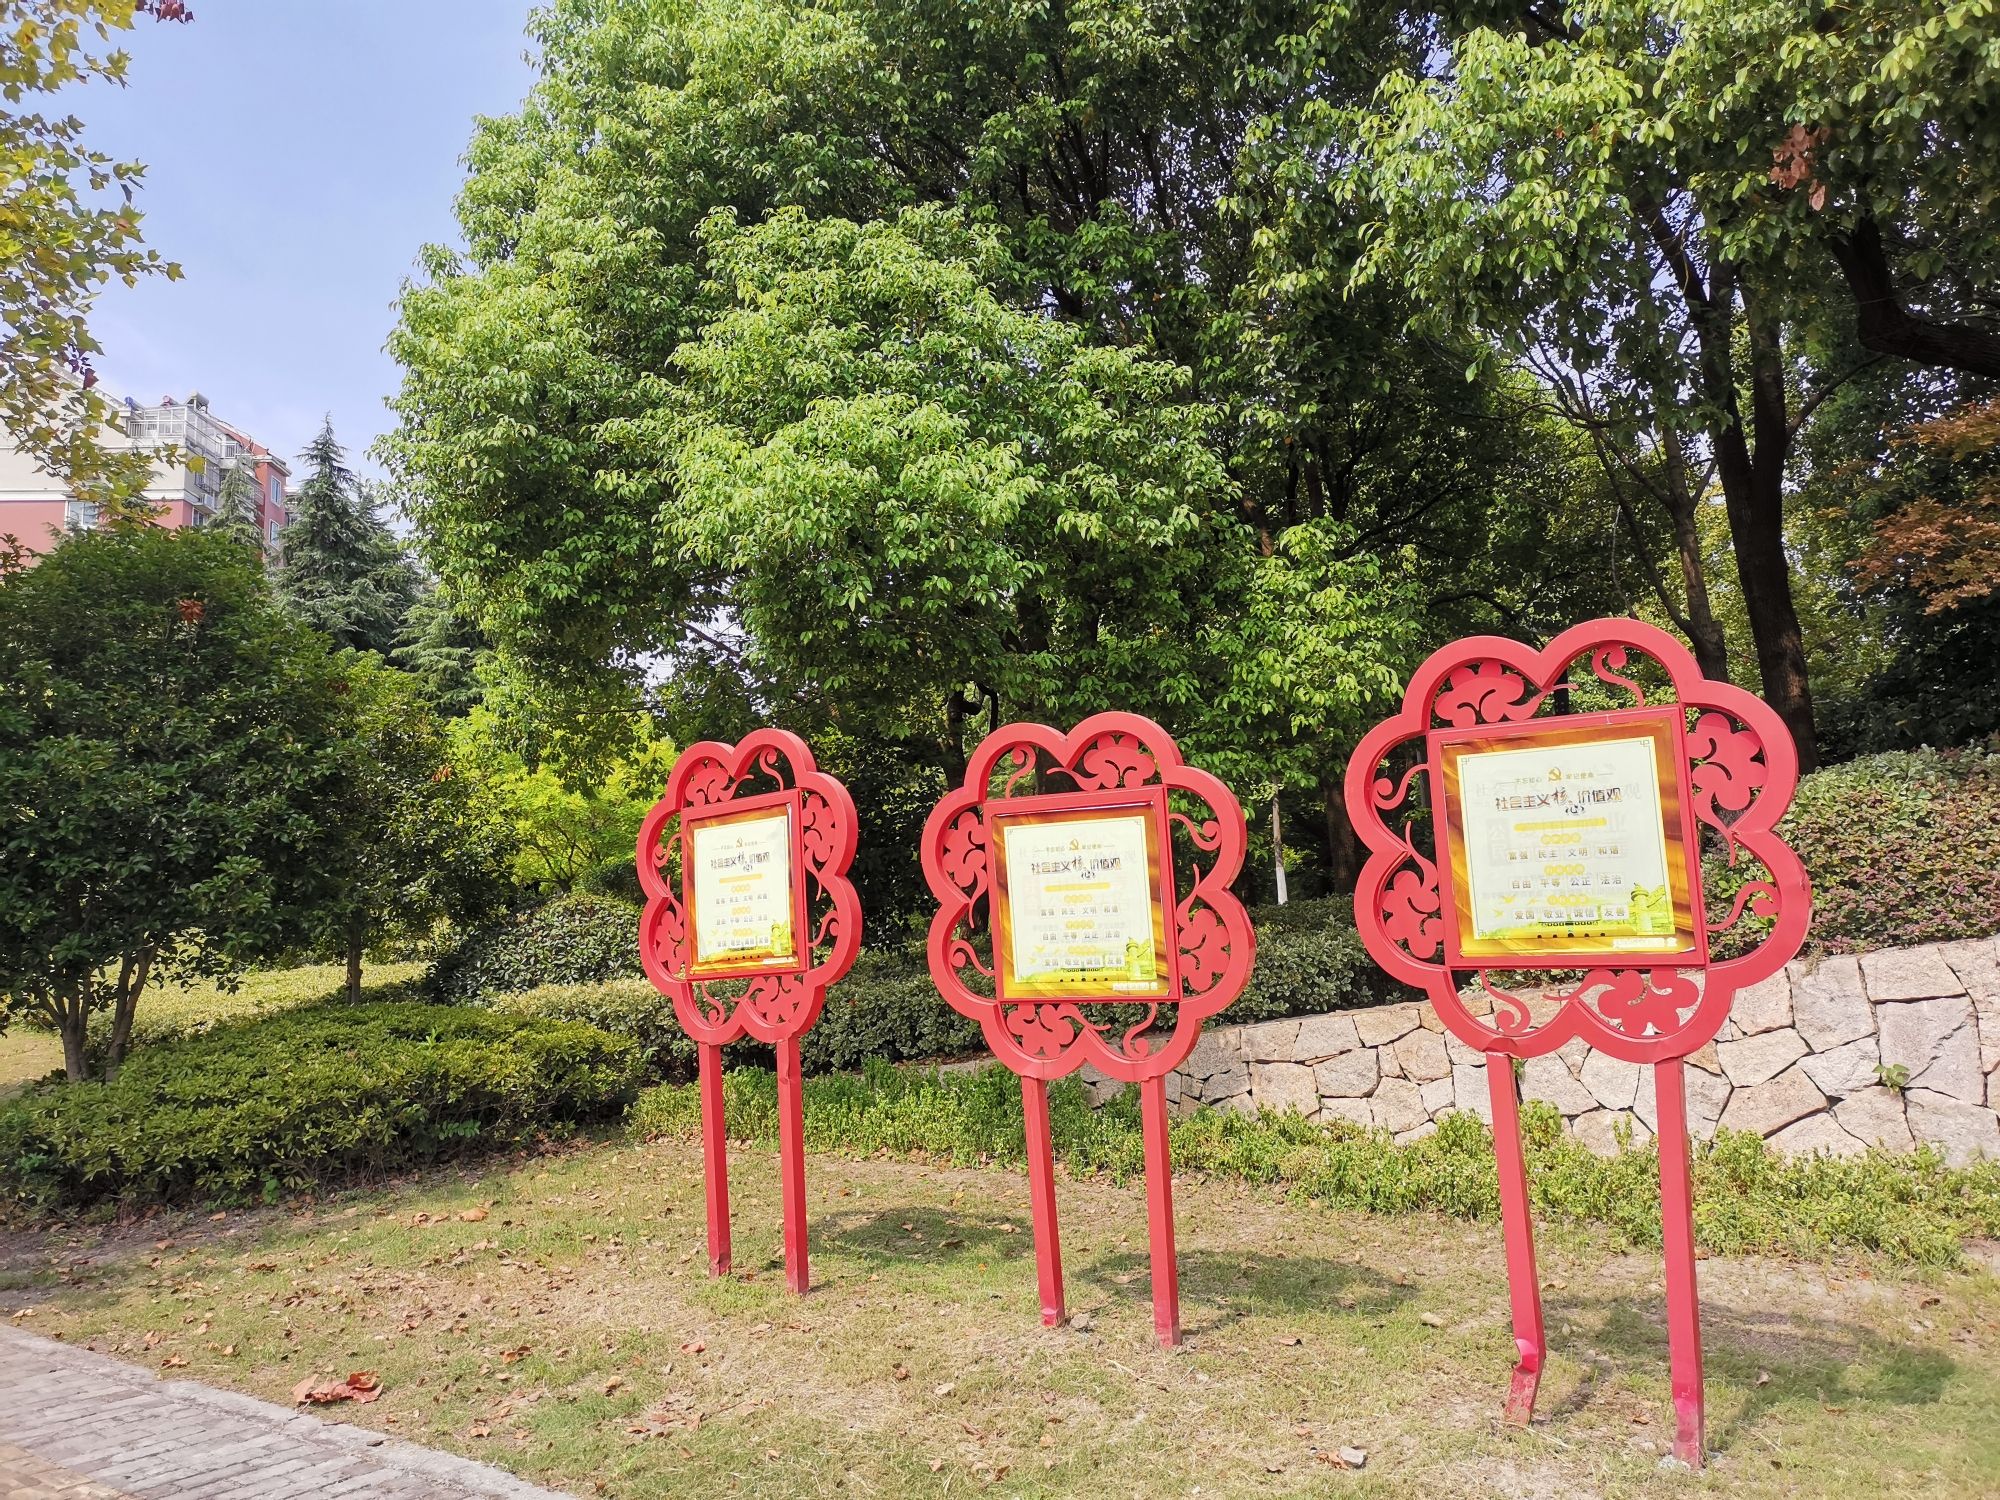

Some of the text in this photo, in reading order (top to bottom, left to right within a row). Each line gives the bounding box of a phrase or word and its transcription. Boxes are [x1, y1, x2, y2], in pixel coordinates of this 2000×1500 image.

[1508, 851, 1529, 861] 富强
[1538, 849, 1559, 859] 民主
[1567, 848, 1589, 858] 文明
[1512, 875, 1622, 889] 自由 平等 公正 法治
[1514, 910, 1535, 920] 爱国
[1604, 907, 1626, 917] 友善
